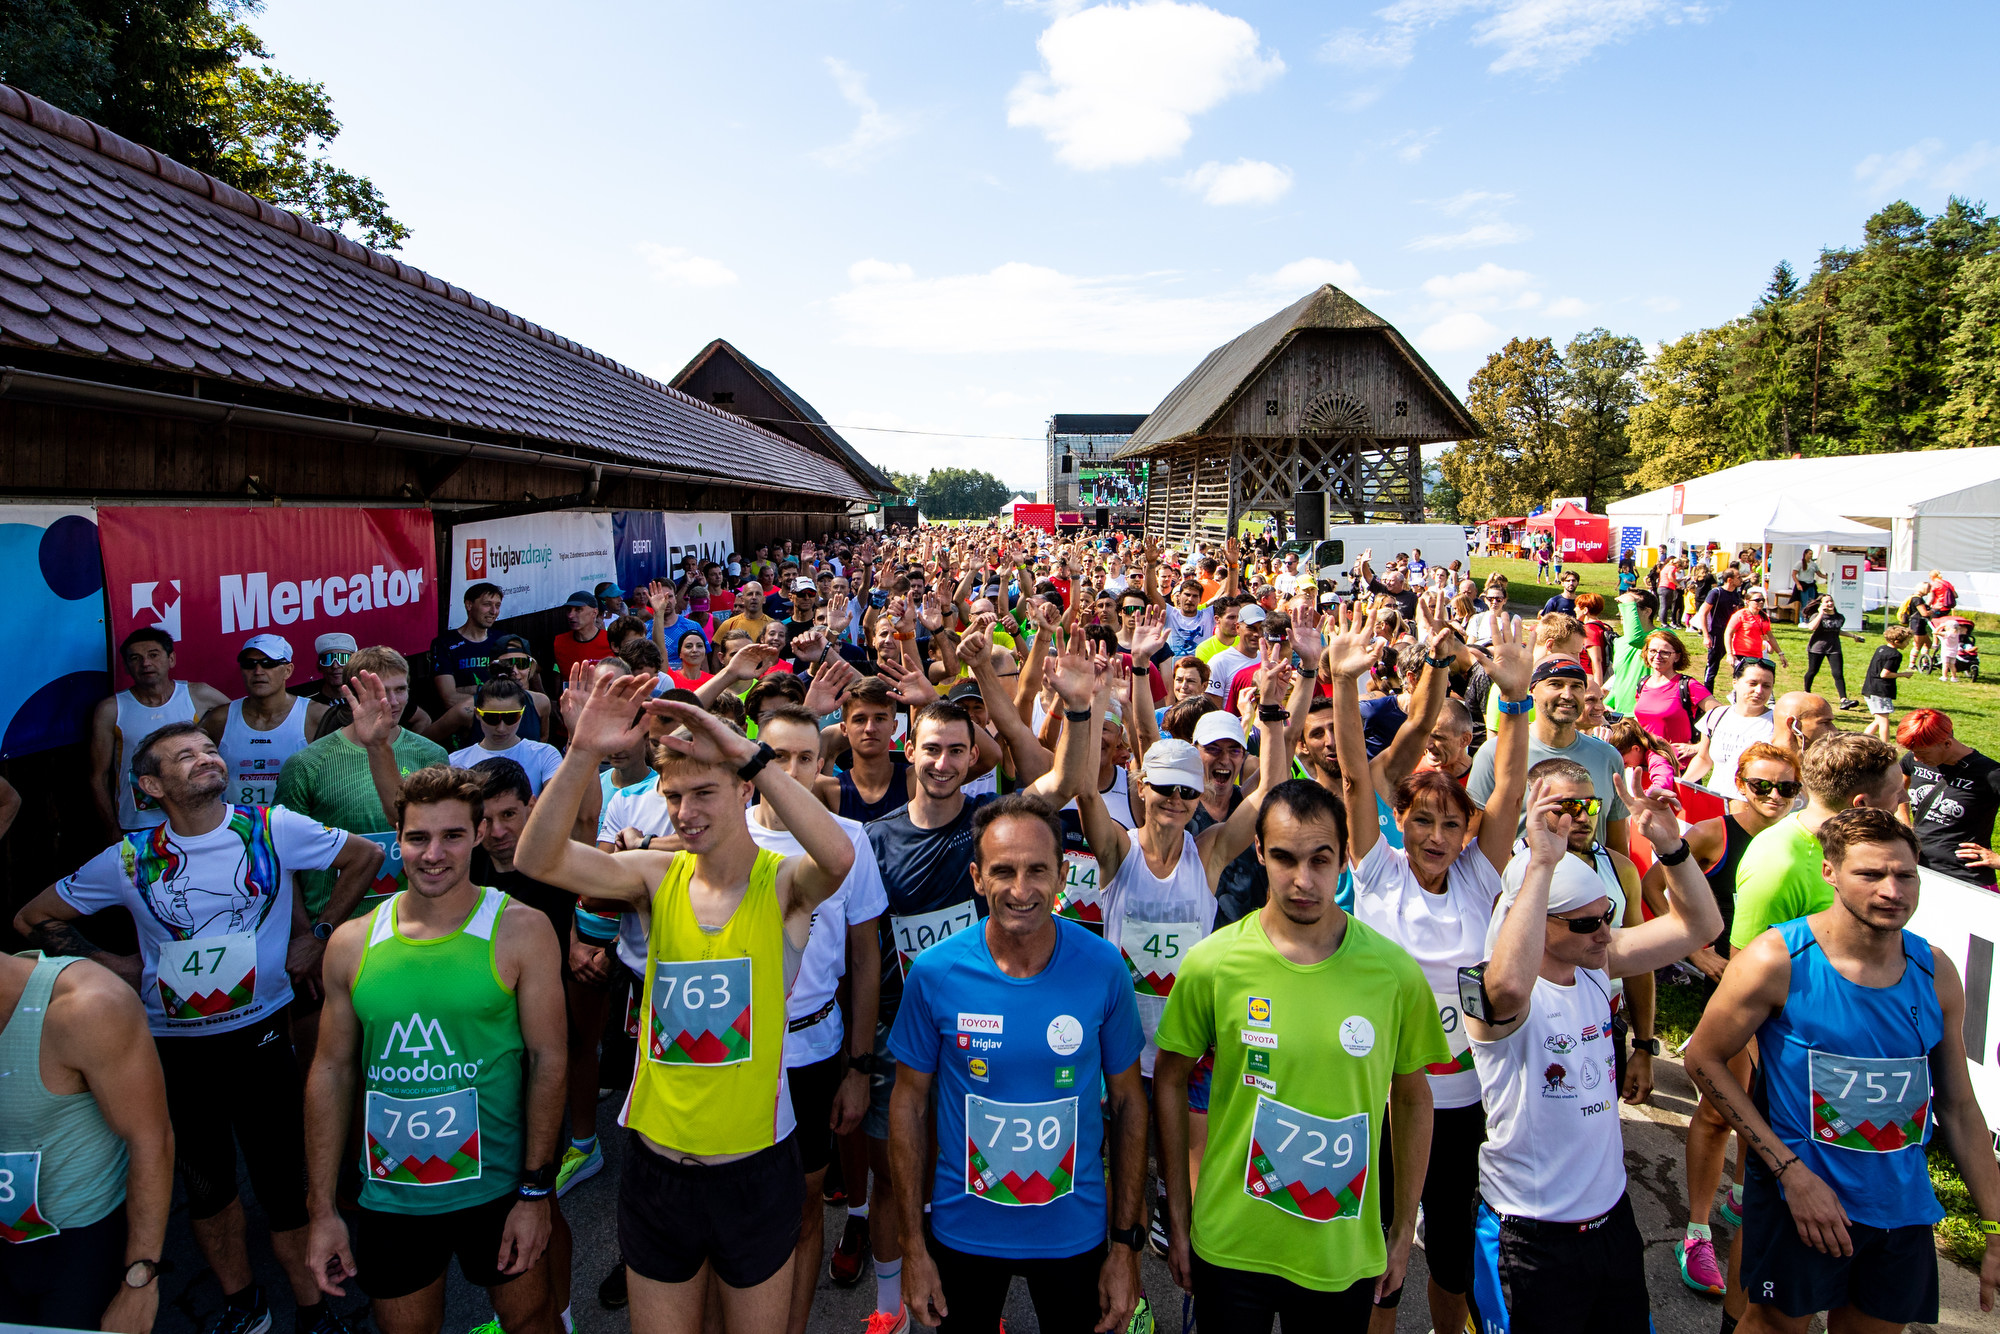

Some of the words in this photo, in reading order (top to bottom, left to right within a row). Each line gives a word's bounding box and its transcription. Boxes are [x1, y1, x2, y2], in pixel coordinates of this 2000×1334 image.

[490, 543, 552, 574] triglavzdravje
[1577, 541, 1603, 551] triglav
[219, 564, 423, 634] Mercator
[240, 787, 268, 804] 81
[900, 913, 972, 953] 1047
[1142, 934, 1180, 959] 45
[182, 946, 227, 977] 47
[658, 974, 731, 1010] 763
[961, 1018, 1000, 1029] TOYOTA
[972, 1038, 1003, 1052] triglav
[1243, 1033, 1275, 1045] TOYOTA
[400, 1087, 420, 1095] WOOD
[420, 1084, 457, 1094] FURNITURE
[1255, 1078, 1274, 1090] triglav
[1833, 1067, 1912, 1103] 757
[384, 1106, 459, 1140] 762
[985, 1114, 1061, 1152] 730
[1276, 1118, 1353, 1169] 729
[1265, 1173, 1279, 1184] tek
